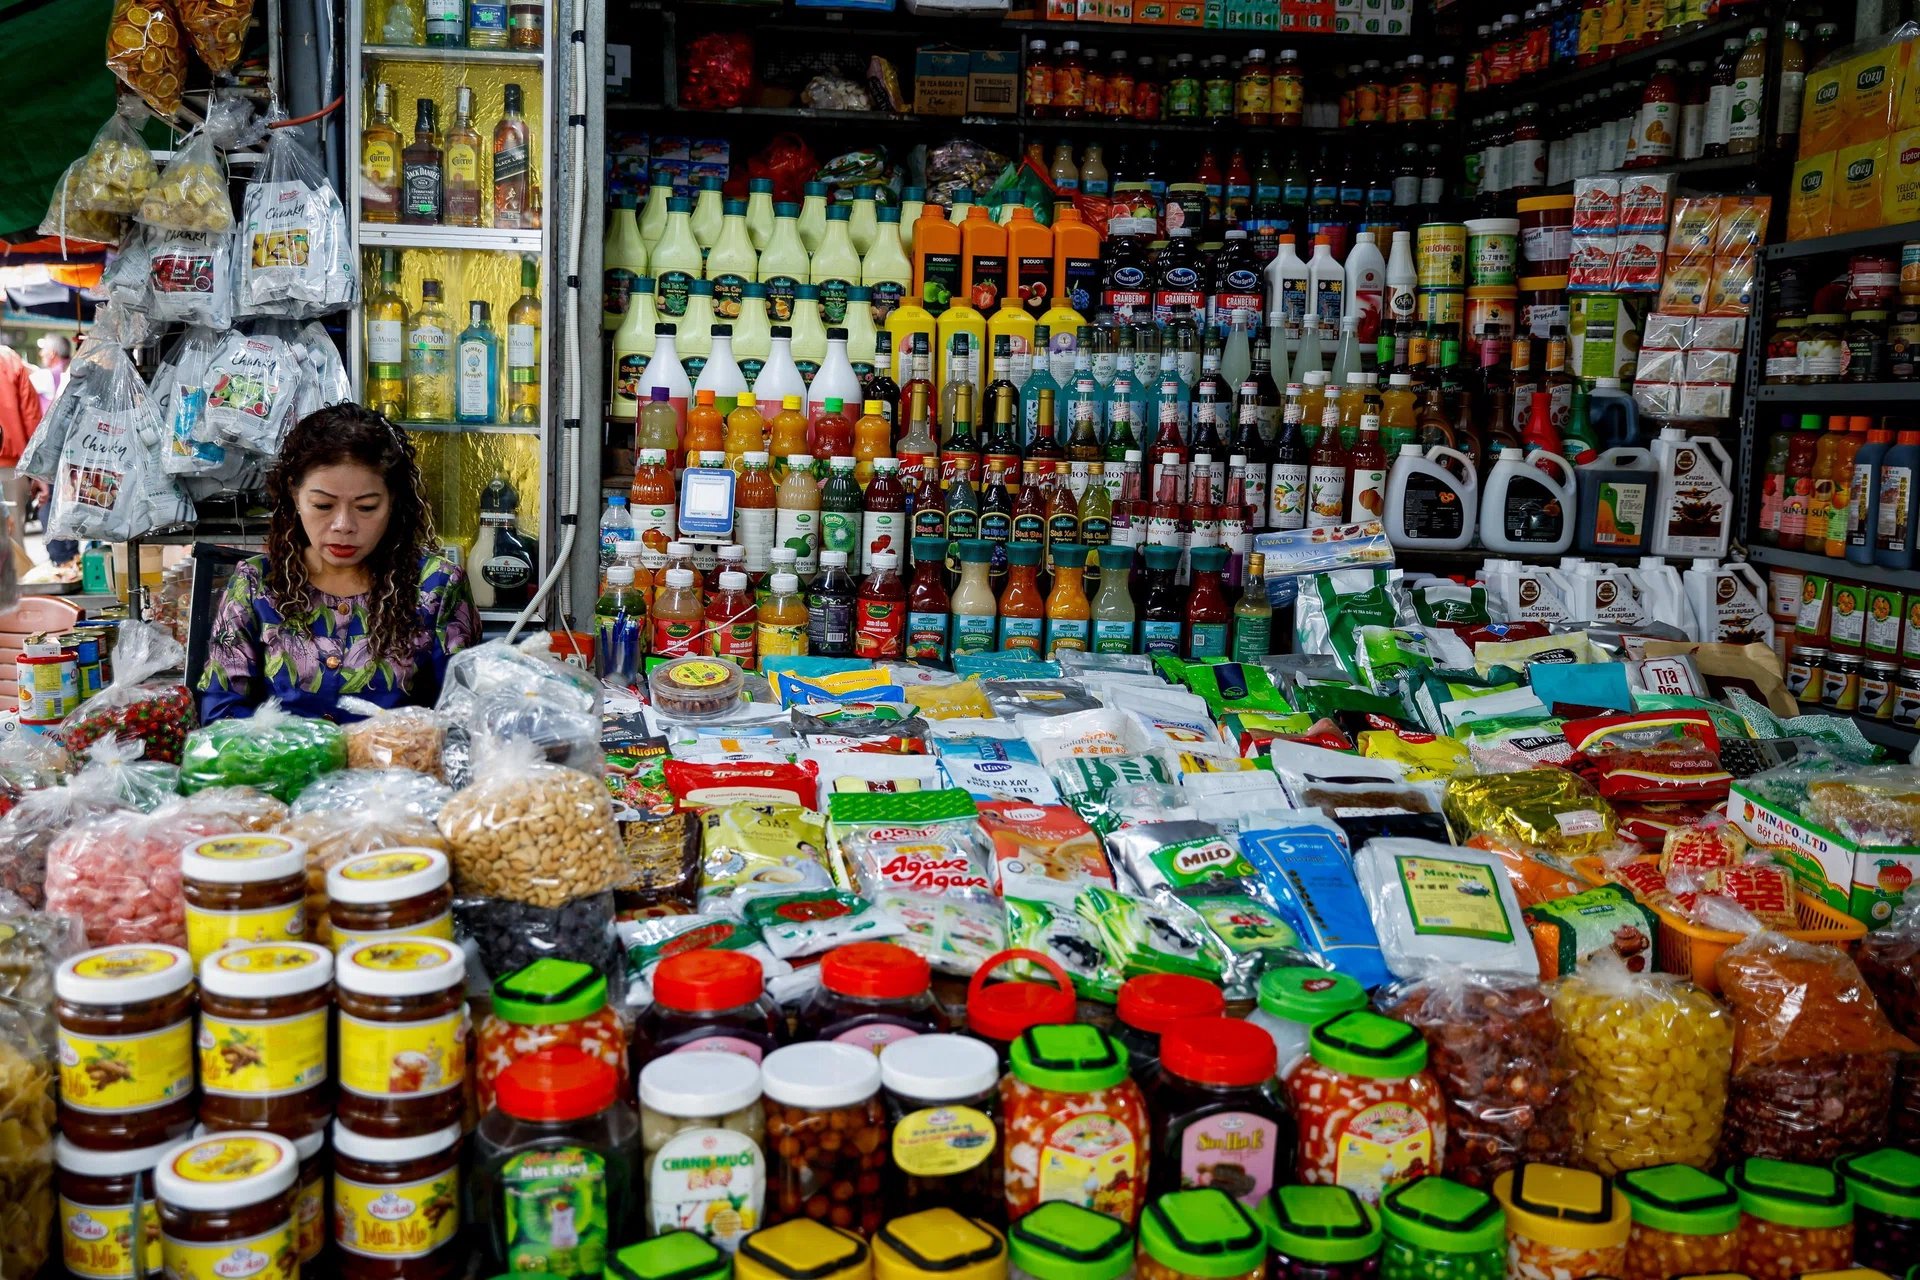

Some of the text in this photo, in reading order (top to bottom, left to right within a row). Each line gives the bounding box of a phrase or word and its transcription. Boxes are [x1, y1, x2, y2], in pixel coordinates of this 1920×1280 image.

[1859, 70, 1883, 85] Cozy
[1818, 85, 1838, 100] Cozy
[406, 168, 420, 180] JACK
[1850, 162, 1872, 177] Cozy
[1803, 174, 1821, 189] Cozy
[1898, 191, 1918, 203] LABEL
[265, 203, 306, 220] Chunky
[1113, 294, 1147, 304] CRANBERRY
[1164, 294, 1200, 304] CRANBERRY
[1226, 297, 1260, 307] CRANBERRY
[232, 350, 278, 376] Chunky
[82, 434, 128, 461] Chunky
[1261, 538, 1293, 546] EWALD
[1530, 604, 1551, 613] Cruzie
[1009, 778, 1029, 786] XAY
[705, 792, 748, 800] Chocolate
[1181, 848, 1231, 868] MILO
[882, 856, 969, 881] Agar
[1424, 868, 1478, 881] Matcha
[892, 872, 989, 895] Agar
[662, 1157, 712, 1171] CHANH
